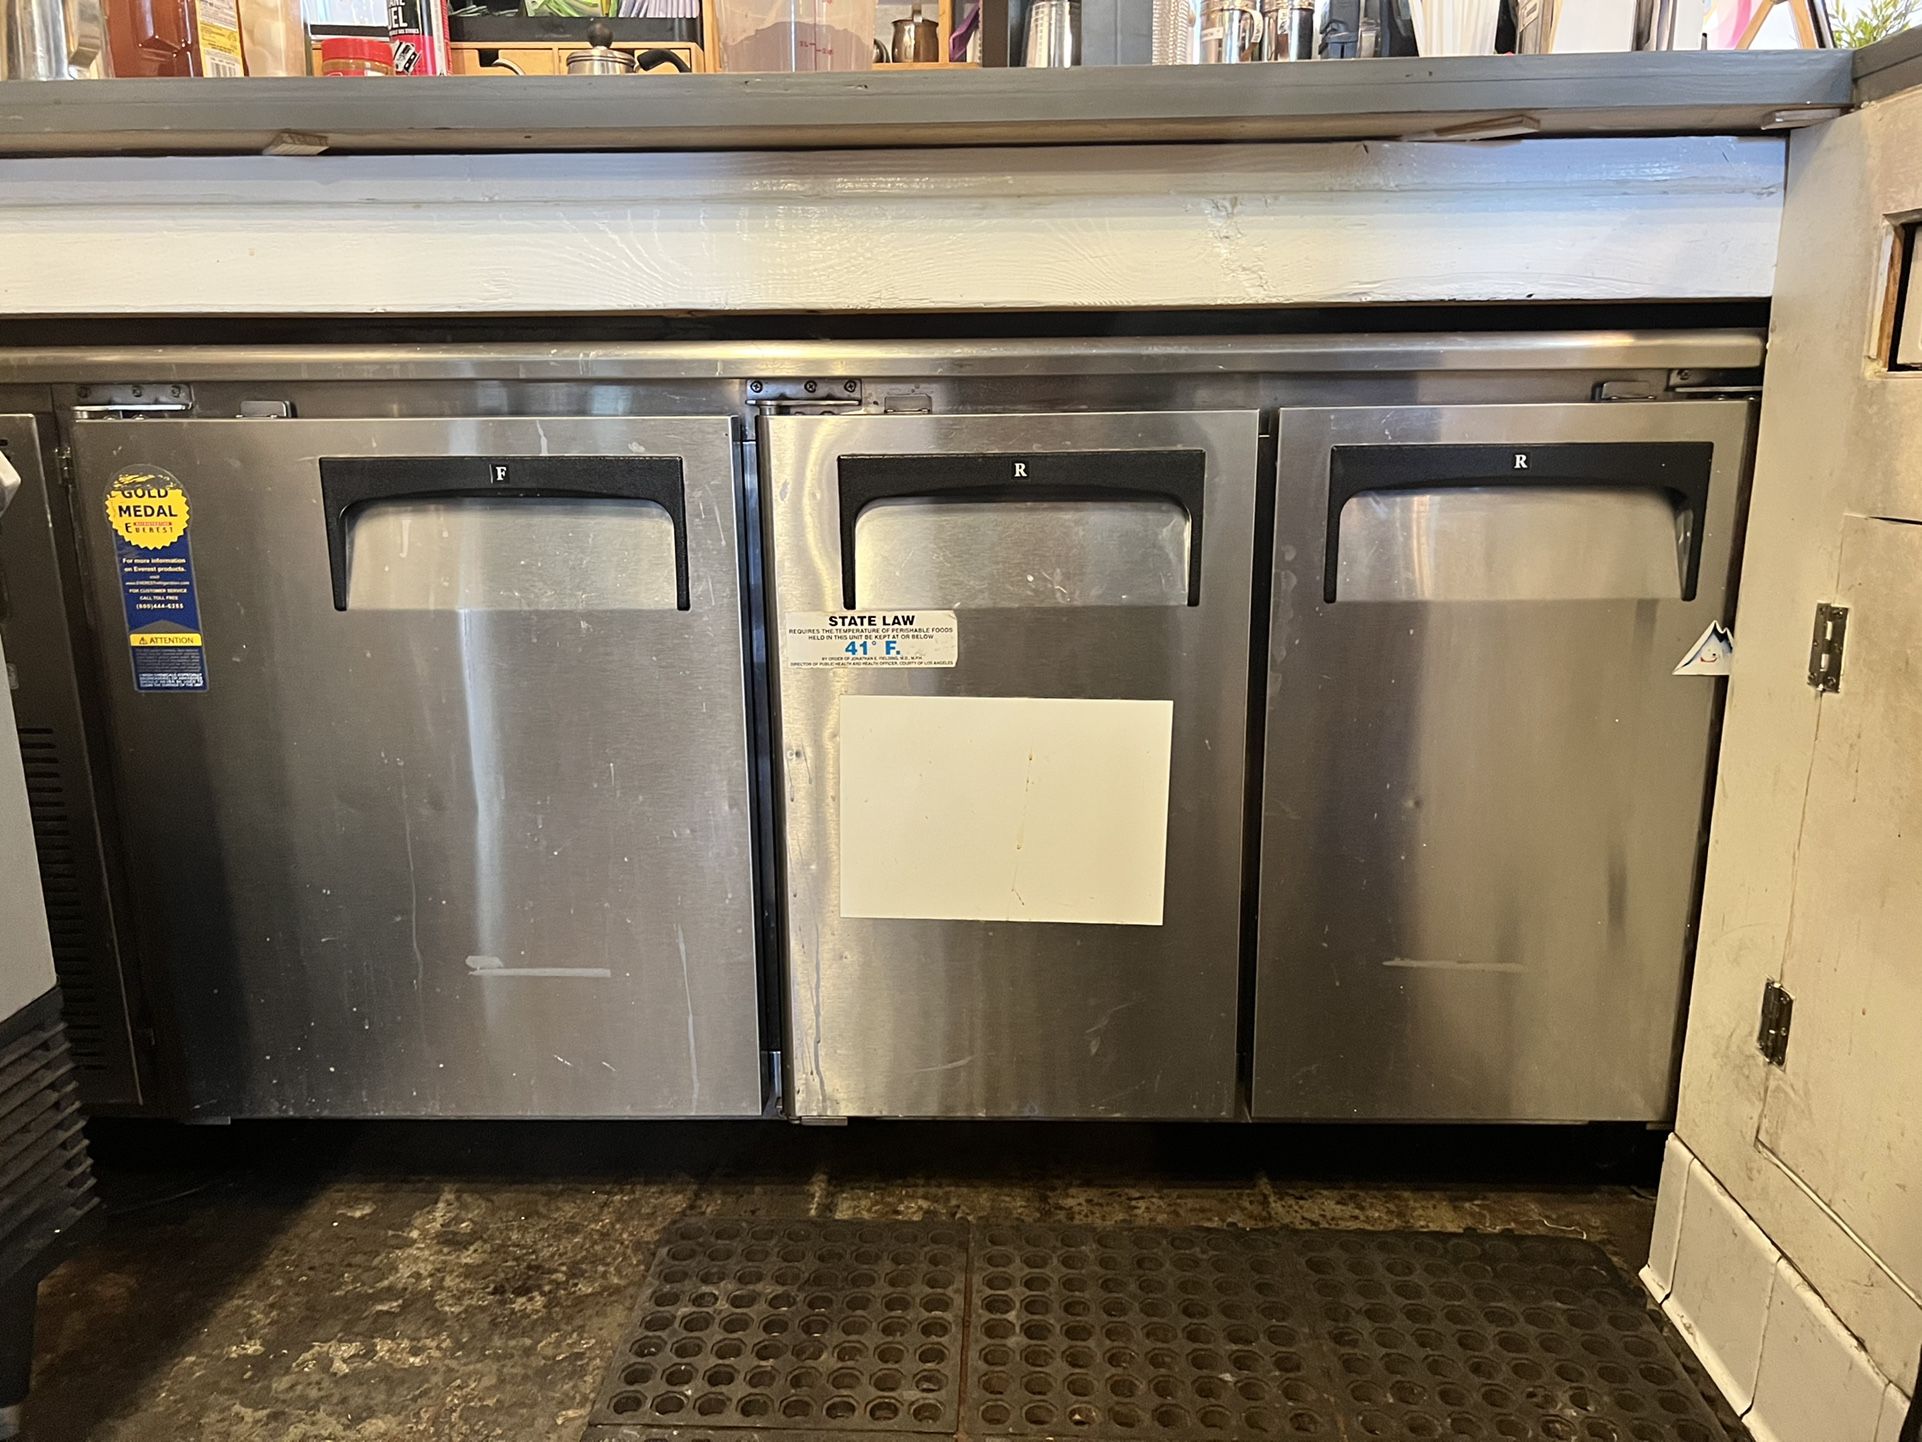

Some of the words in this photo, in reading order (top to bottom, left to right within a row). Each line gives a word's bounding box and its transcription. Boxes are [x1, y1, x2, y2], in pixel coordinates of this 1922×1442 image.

[1514, 454, 1528, 469] R
[496, 466, 507, 481] F
[1014, 462, 1028, 478] R
[121, 488, 169, 499] GOLD
[118, 505, 178, 518] MEDAL
[829, 615, 877, 627] STATE
[882, 615, 916, 627] LAW
[149, 637, 194, 645] ATTENTION
[885, 640, 901, 656] F.
